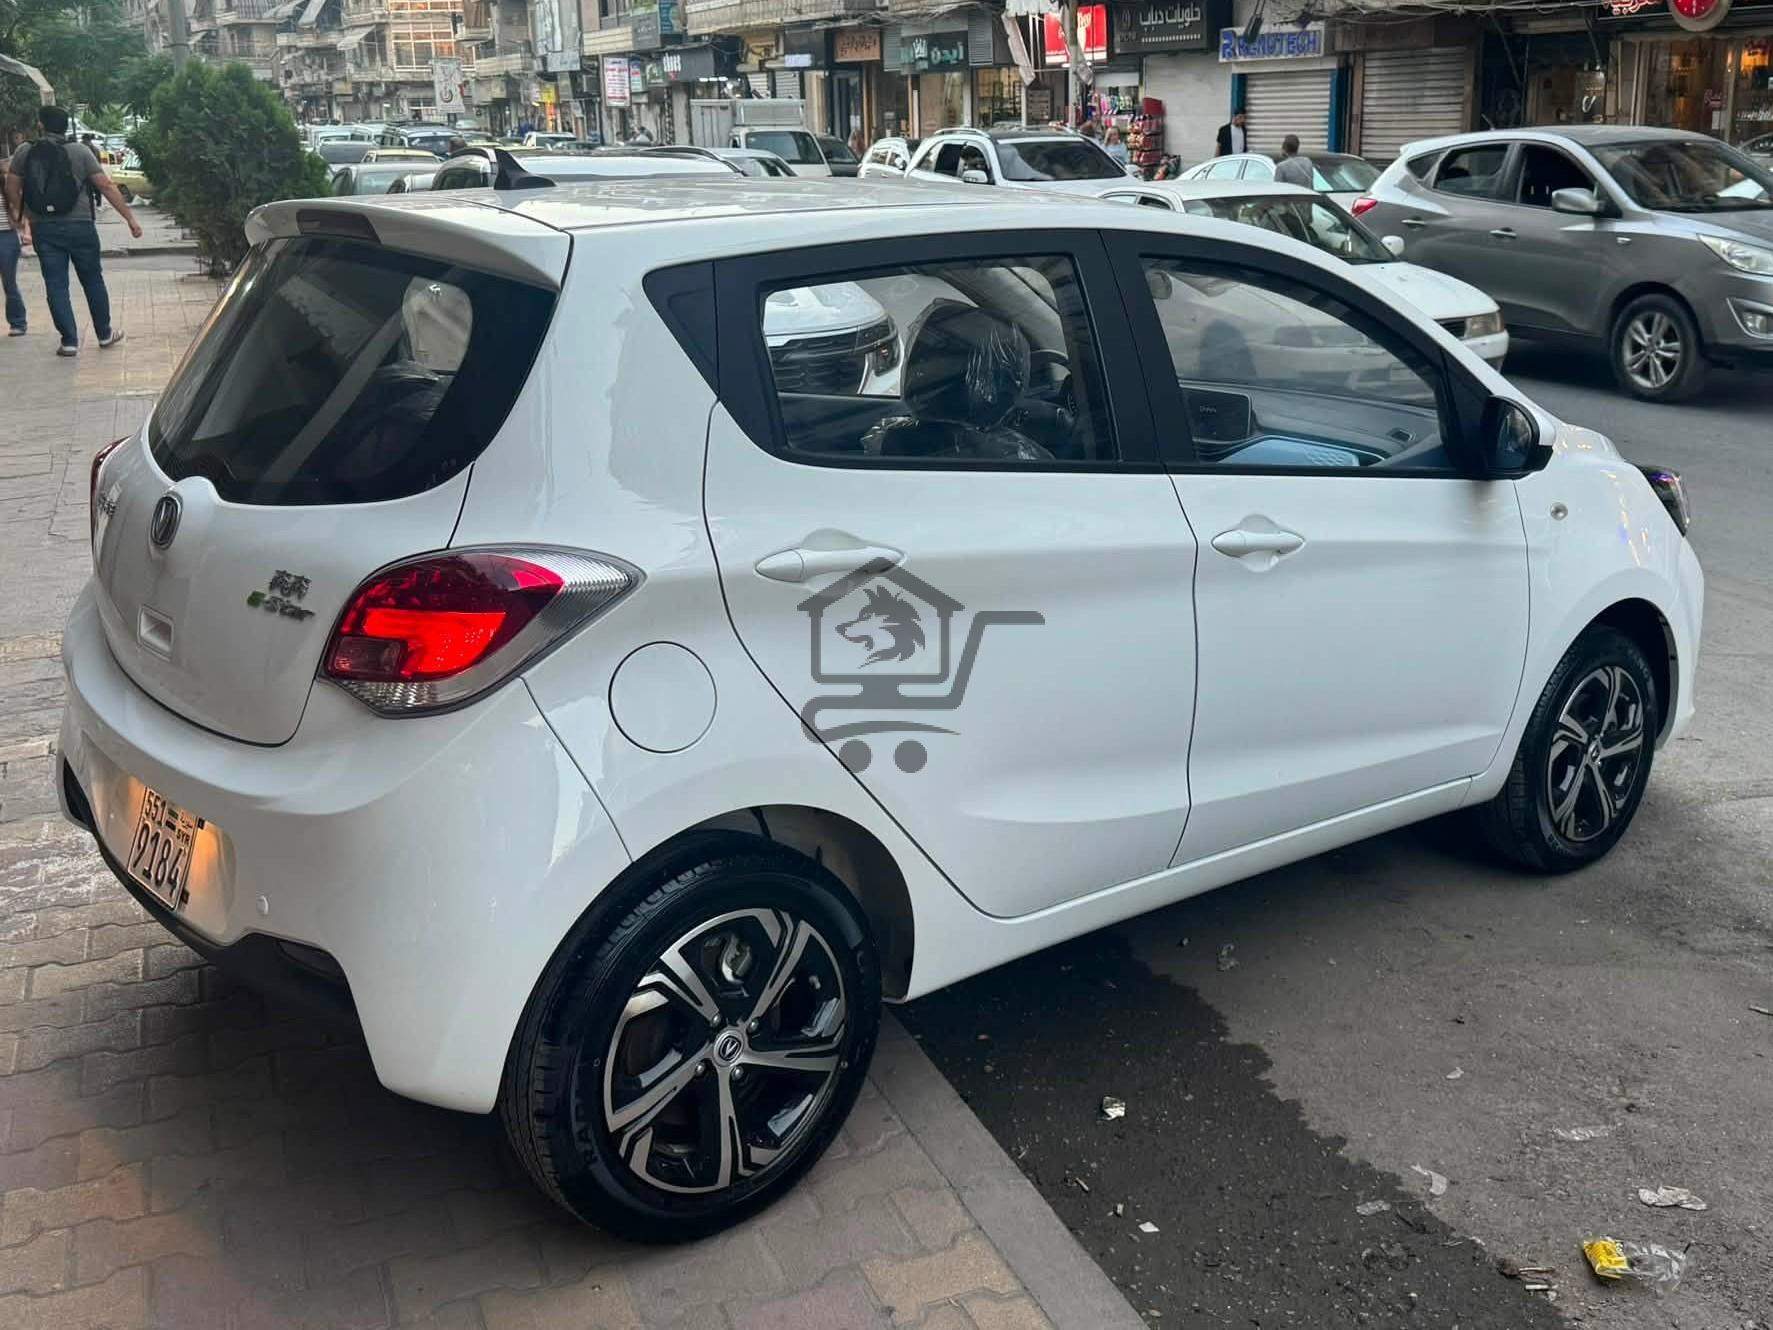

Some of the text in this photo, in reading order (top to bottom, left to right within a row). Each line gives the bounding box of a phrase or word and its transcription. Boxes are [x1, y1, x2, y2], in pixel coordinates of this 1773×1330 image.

[1165, 2, 1201, 29] حلويات
[145, 790, 167, 827] 551
[132, 821, 183, 898] 9184
